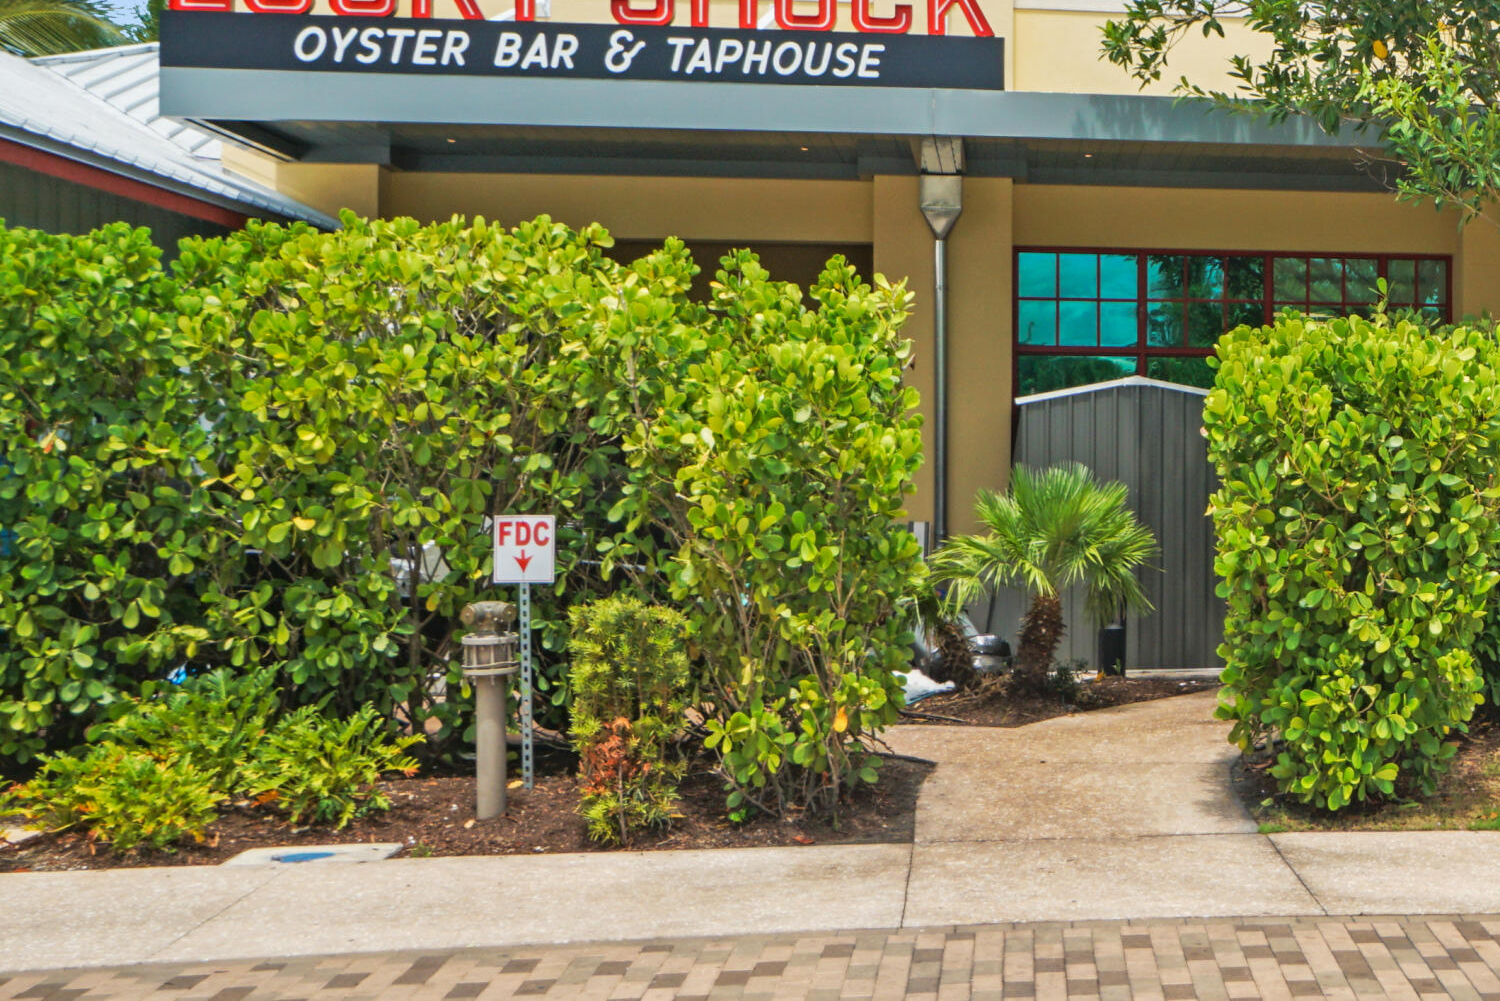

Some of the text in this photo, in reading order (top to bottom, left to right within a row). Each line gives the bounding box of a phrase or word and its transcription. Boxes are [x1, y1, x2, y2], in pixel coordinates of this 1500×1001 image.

[294, 25, 886, 79] OYSTER BAR & TAPHOUSE
[498, 521, 550, 547] FDC
